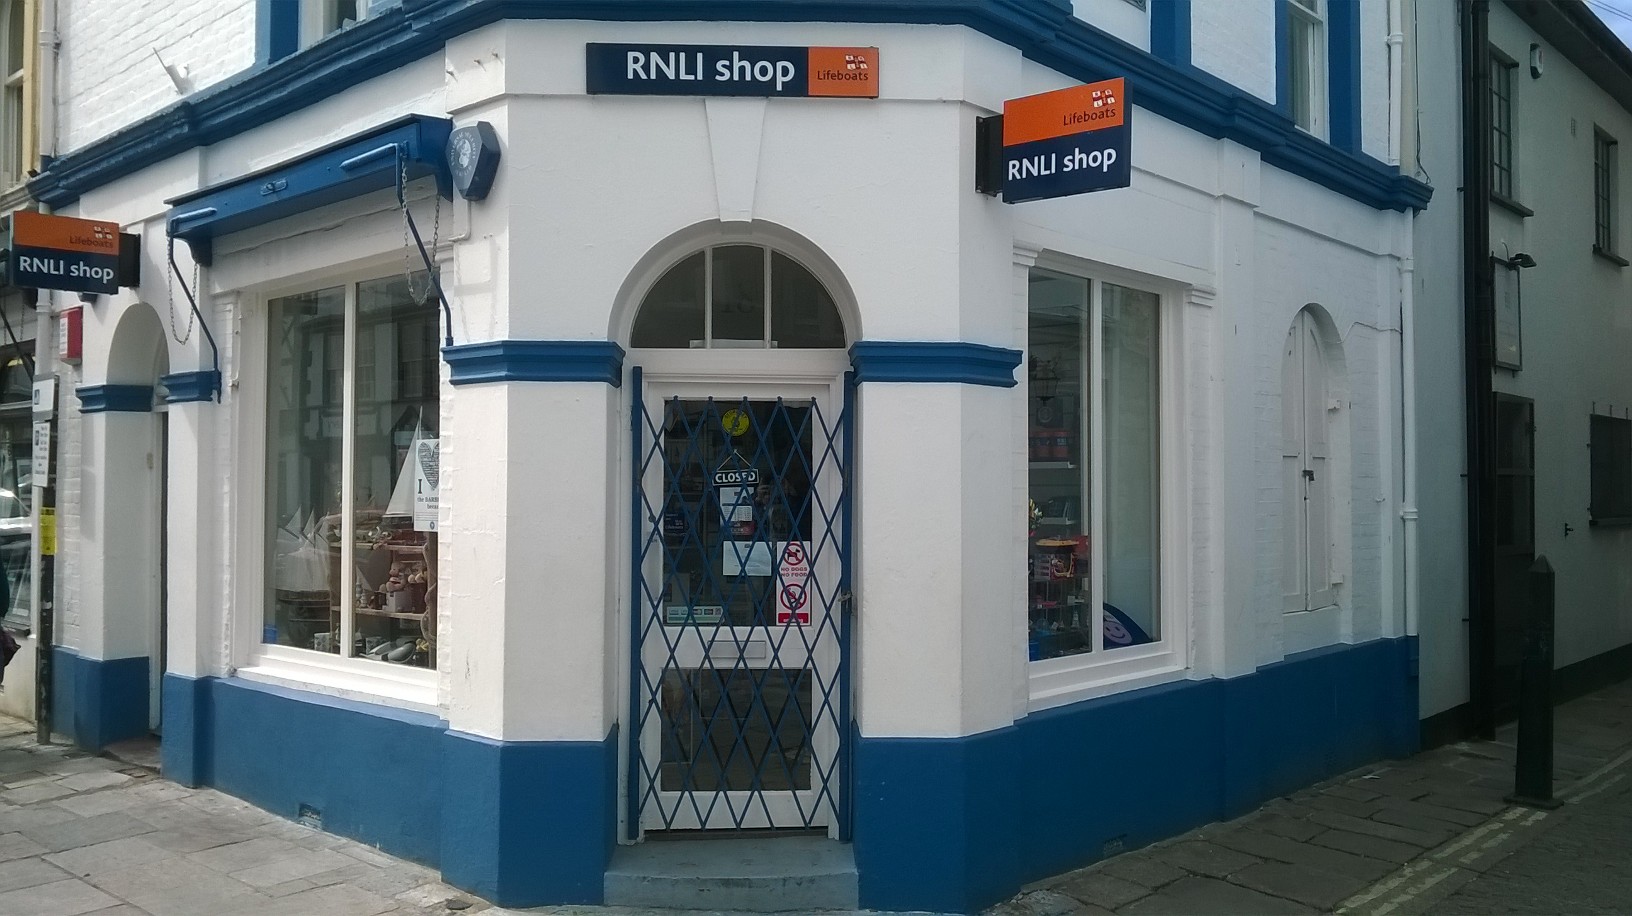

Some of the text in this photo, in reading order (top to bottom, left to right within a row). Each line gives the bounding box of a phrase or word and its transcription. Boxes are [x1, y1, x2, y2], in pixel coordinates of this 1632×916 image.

[627, 51, 795, 91] RNLI shop
[817, 69, 869, 81] Lifeboats
[1063, 108, 1116, 126] Lifeboats
[1008, 147, 1117, 181] RNLI shop
[69, 235, 114, 249] Lifeboats
[20, 256, 115, 284] RNLI shop
[715, 472, 756, 483] CLOSED
[417, 479, 423, 494] I
